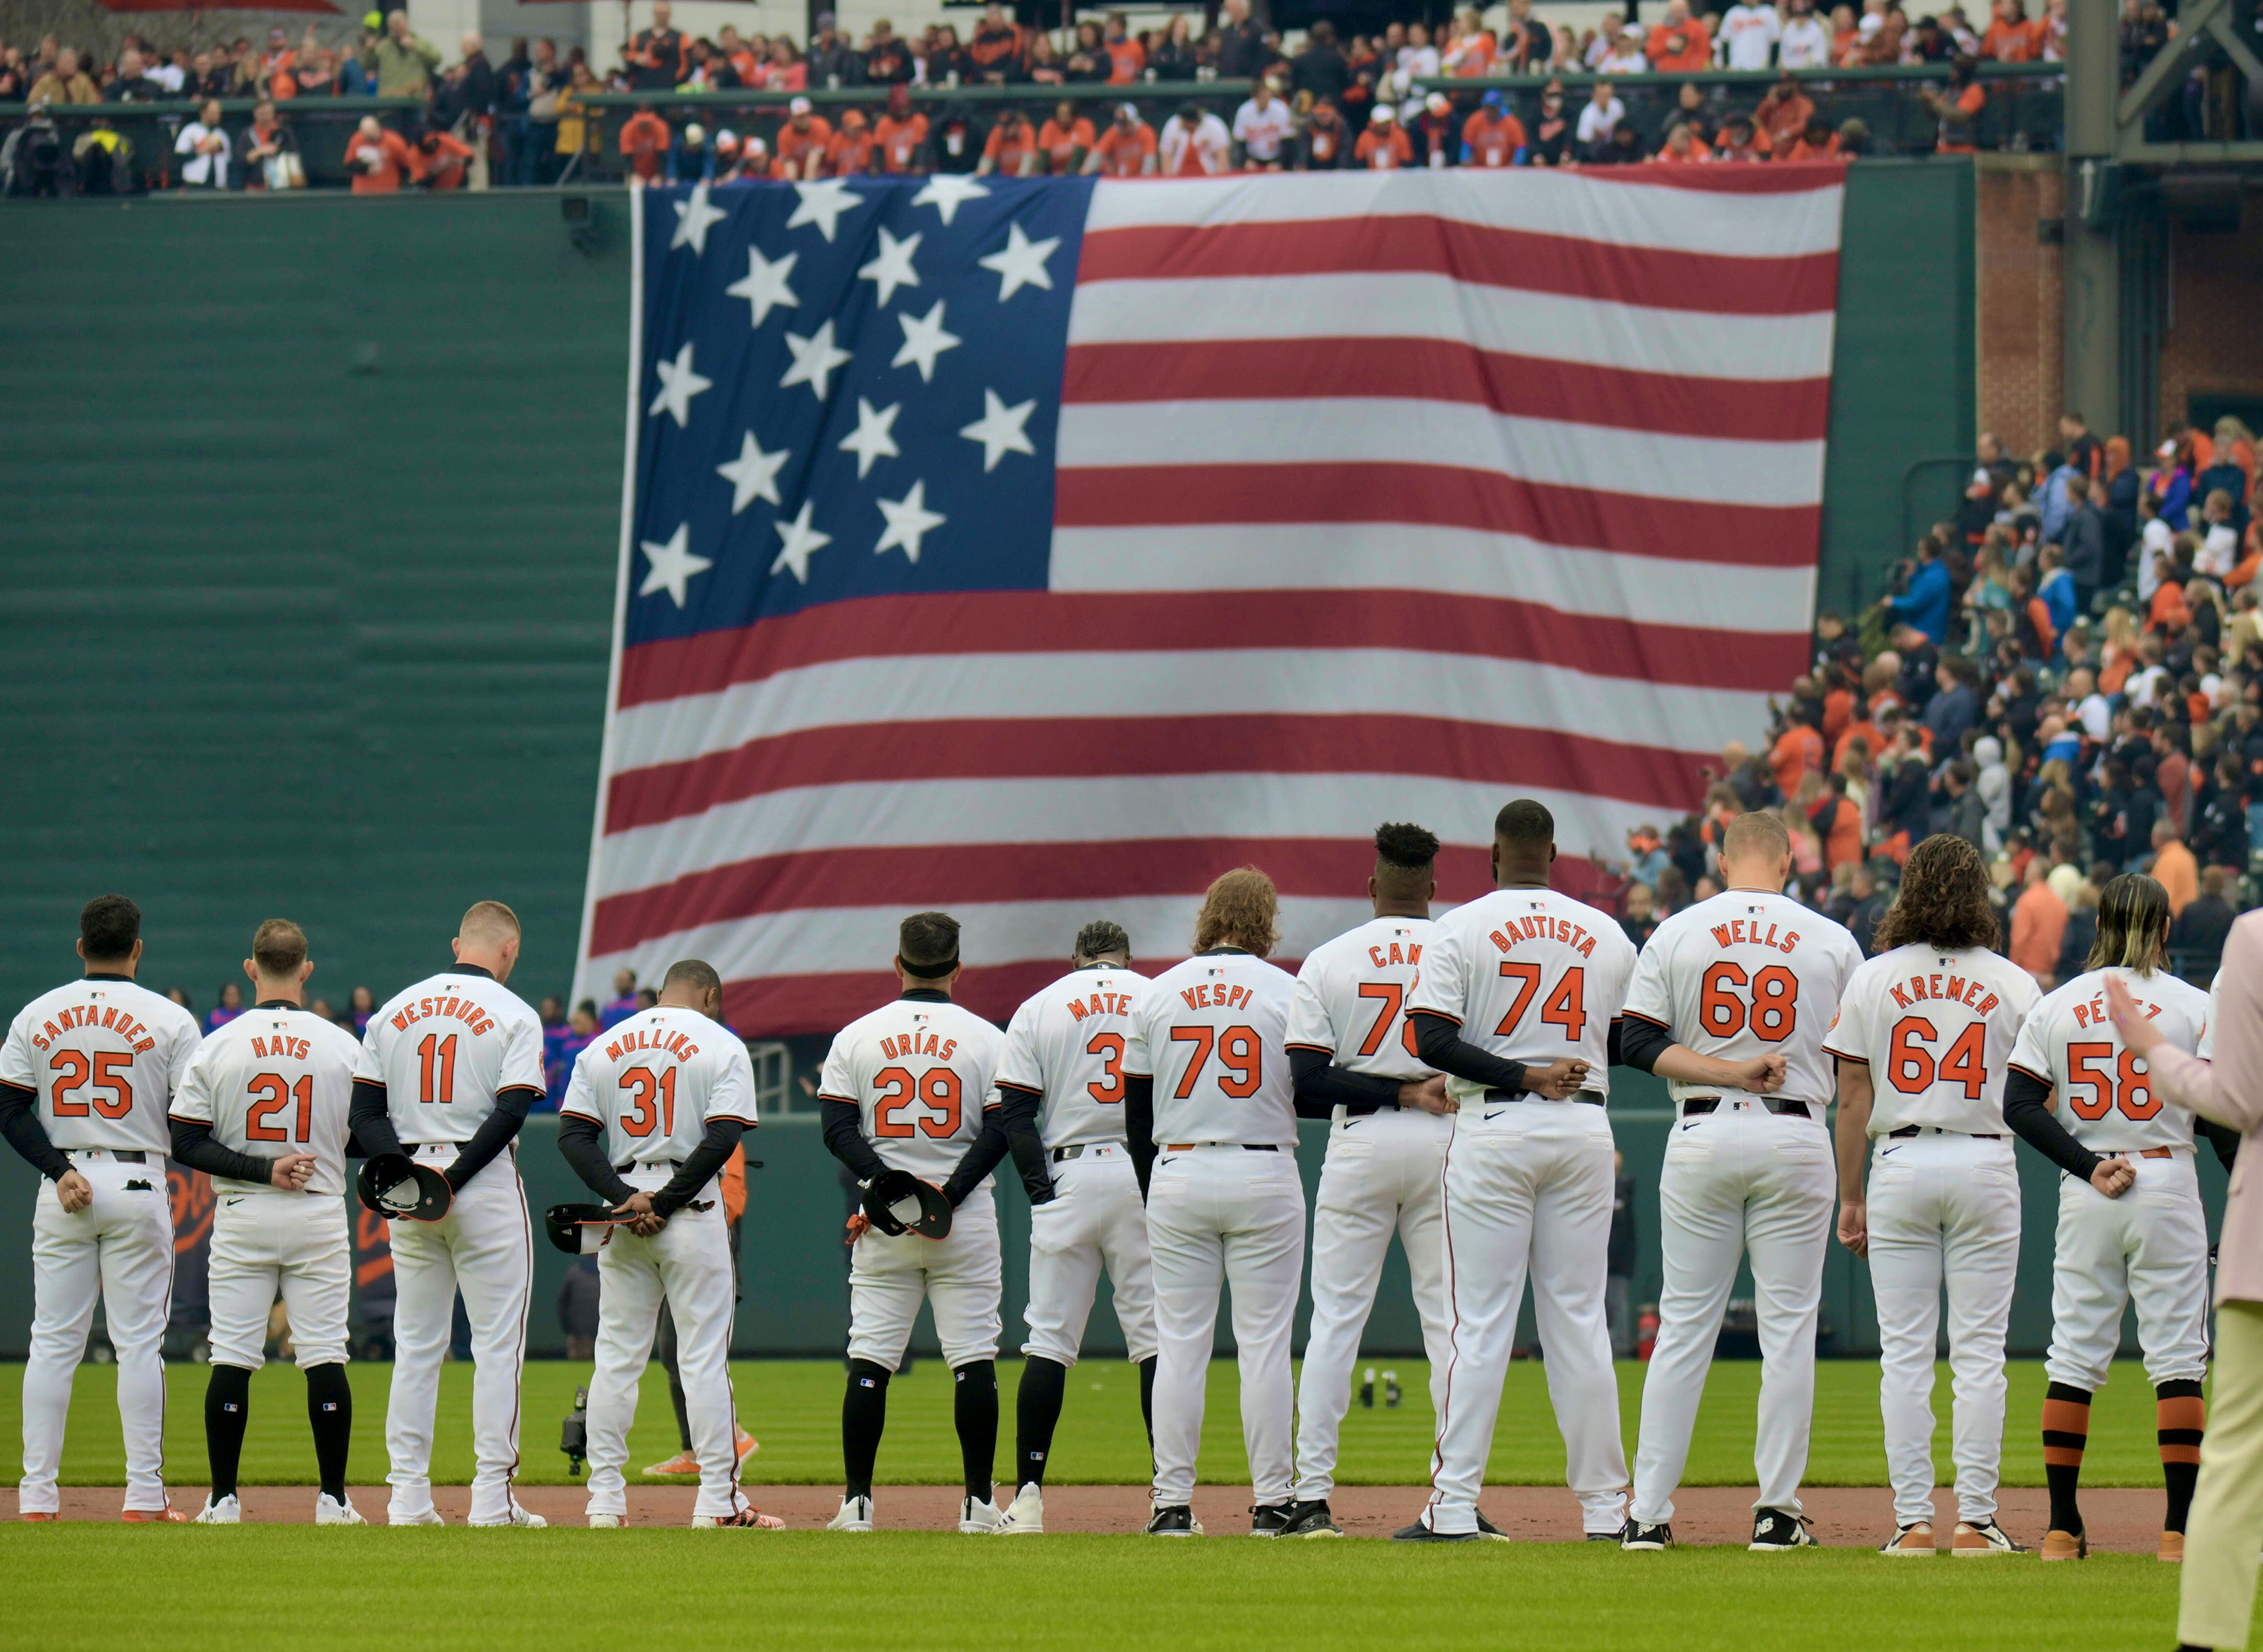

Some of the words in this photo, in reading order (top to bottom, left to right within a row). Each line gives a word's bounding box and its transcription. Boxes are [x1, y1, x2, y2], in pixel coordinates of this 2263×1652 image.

[1368, 942, 1423, 969] CAN
[1489, 915, 1596, 959] BAUTISTA
[1709, 920, 1801, 953] WELLS
[391, 996, 495, 1036] WESTBURG
[1067, 993, 1132, 1022] MATE
[1181, 983, 1254, 1011] VESPI
[1494, 961, 1586, 1042] 74
[1700, 960, 1799, 1042] 68
[1890, 973, 1999, 1017] KREMER
[2072, 990, 2163, 1029] PÉZ
[32, 1005, 156, 1055] SANTANDER
[250, 1034, 312, 1060] HAYS
[605, 1028, 699, 1062] MULLINS
[880, 1026, 958, 1061] URÍAS
[416, 1033, 458, 1104] 11
[1086, 1032, 1126, 1104] 3
[1170, 1024, 1262, 1099] 79
[1887, 1015, 1988, 1100] 64
[2067, 1042, 2164, 1121] 58
[49, 1049, 134, 1119] 25
[245, 1072, 314, 1144] 21
[618, 1065, 677, 1138] 31
[872, 1066, 963, 1139] 29
